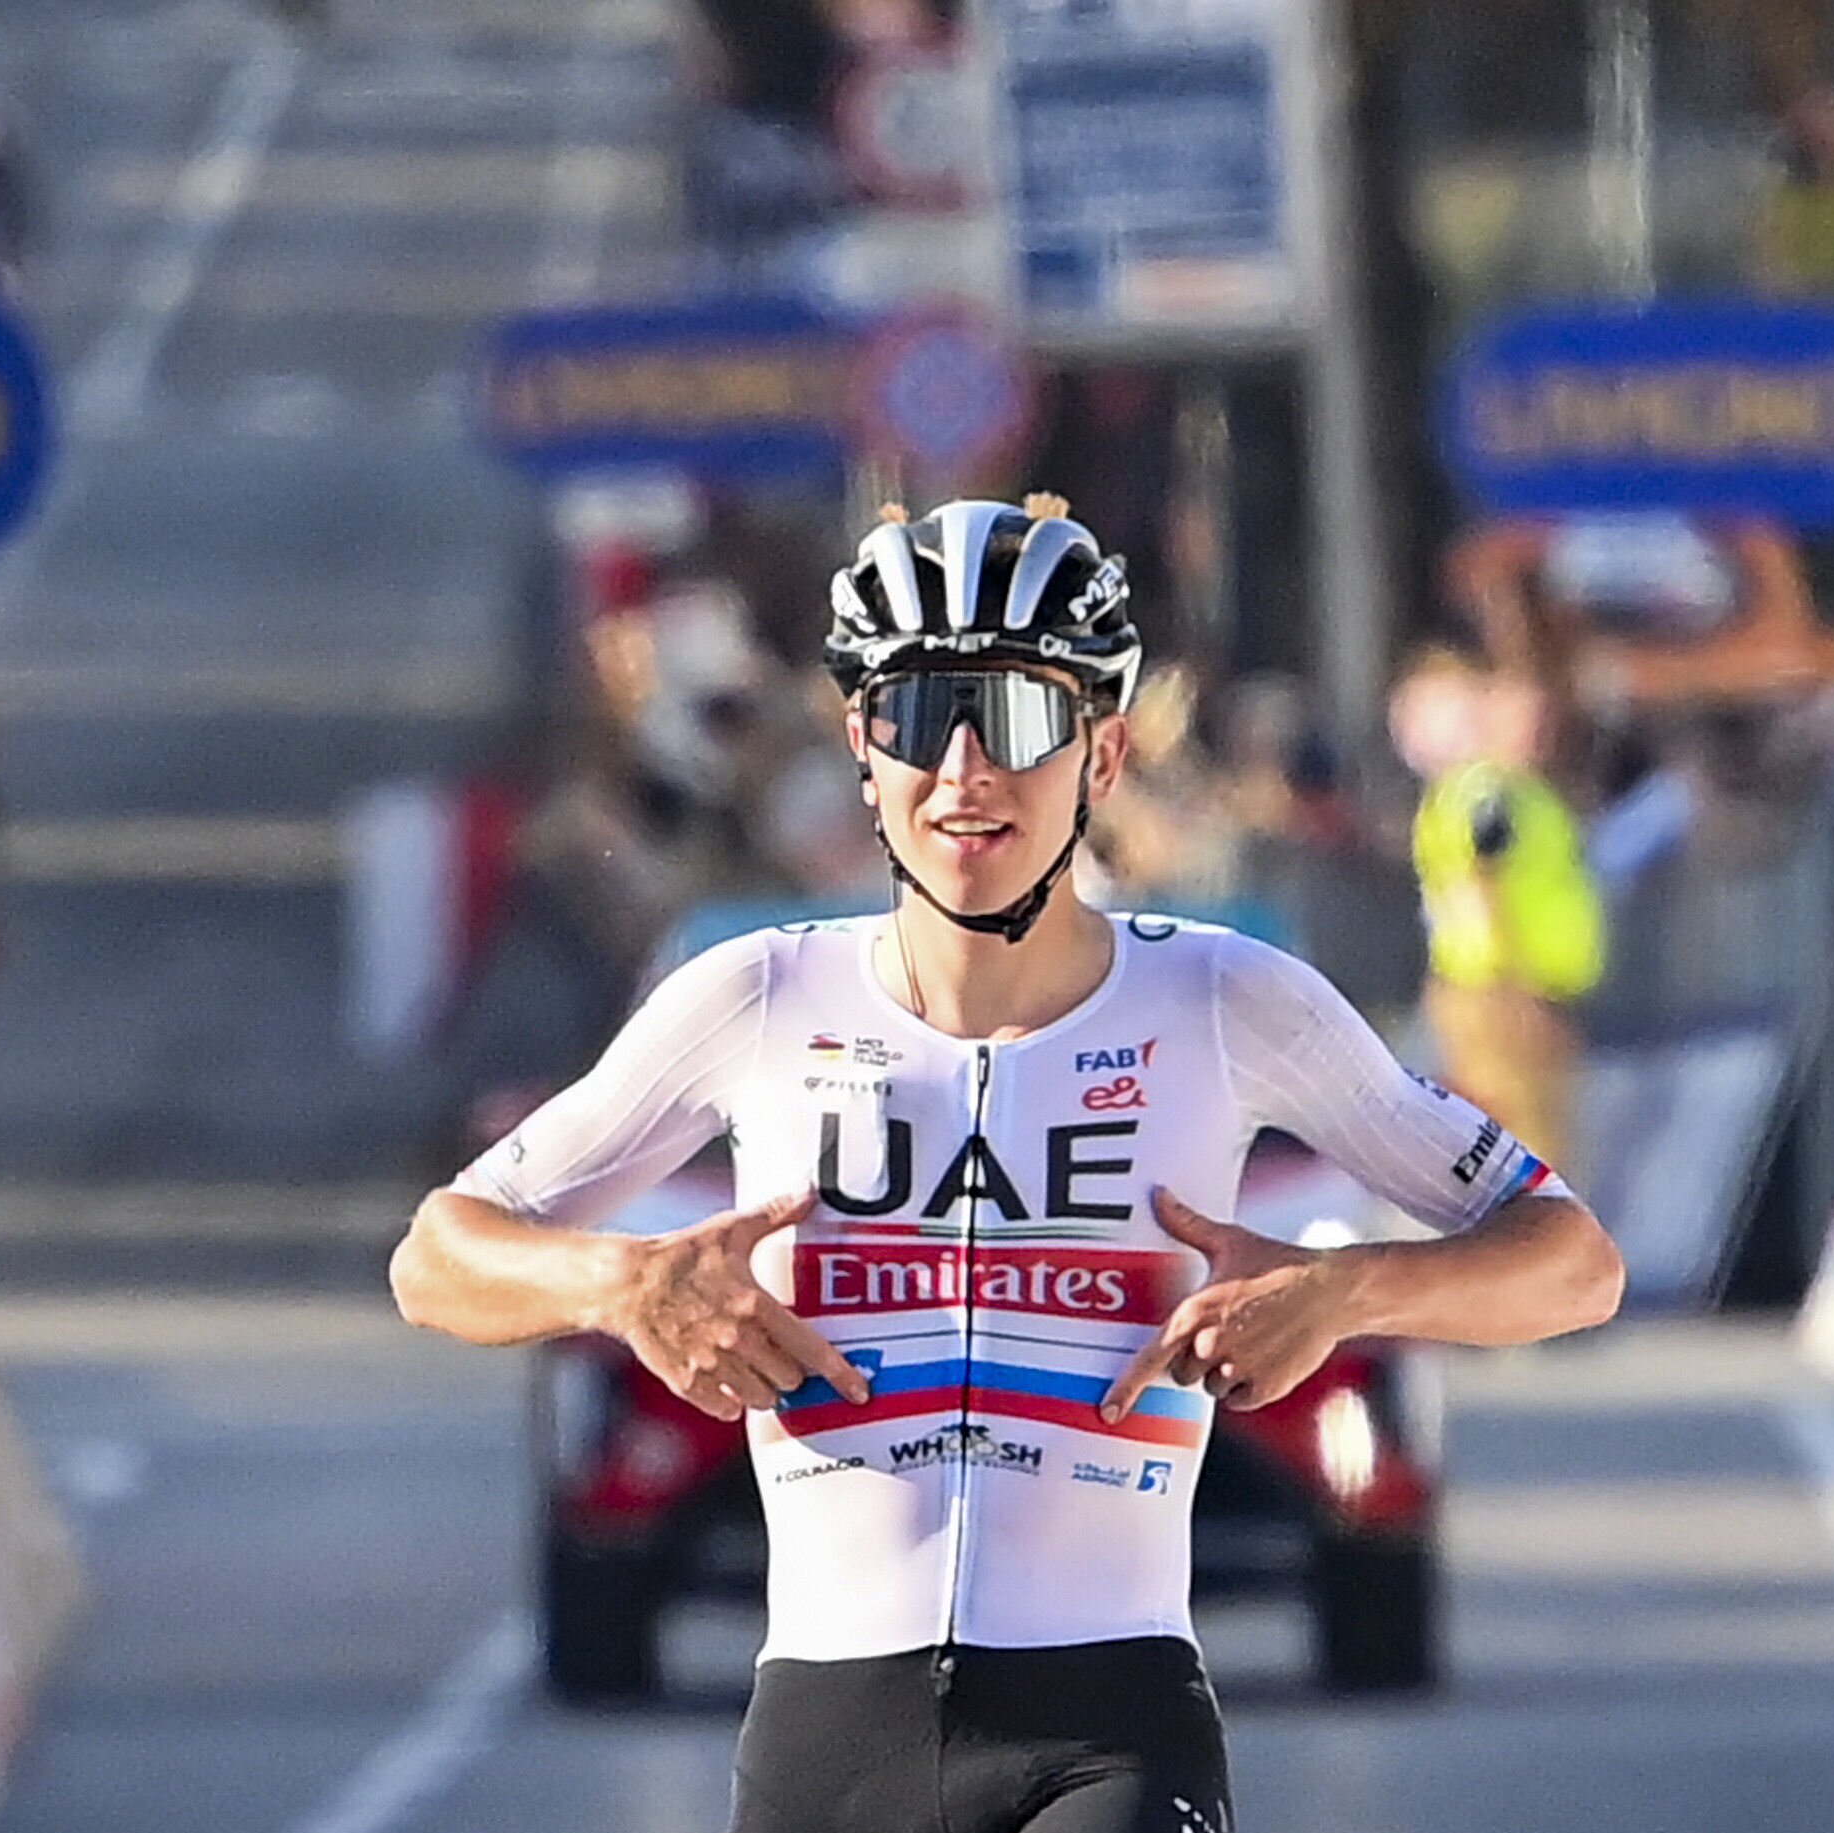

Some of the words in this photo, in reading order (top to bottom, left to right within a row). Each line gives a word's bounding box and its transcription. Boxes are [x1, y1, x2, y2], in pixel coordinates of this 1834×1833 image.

[1076, 1048, 1137, 1073] FAB
[819, 1112, 1138, 1220] UAE
[818, 1251, 1126, 1311] Emirates
